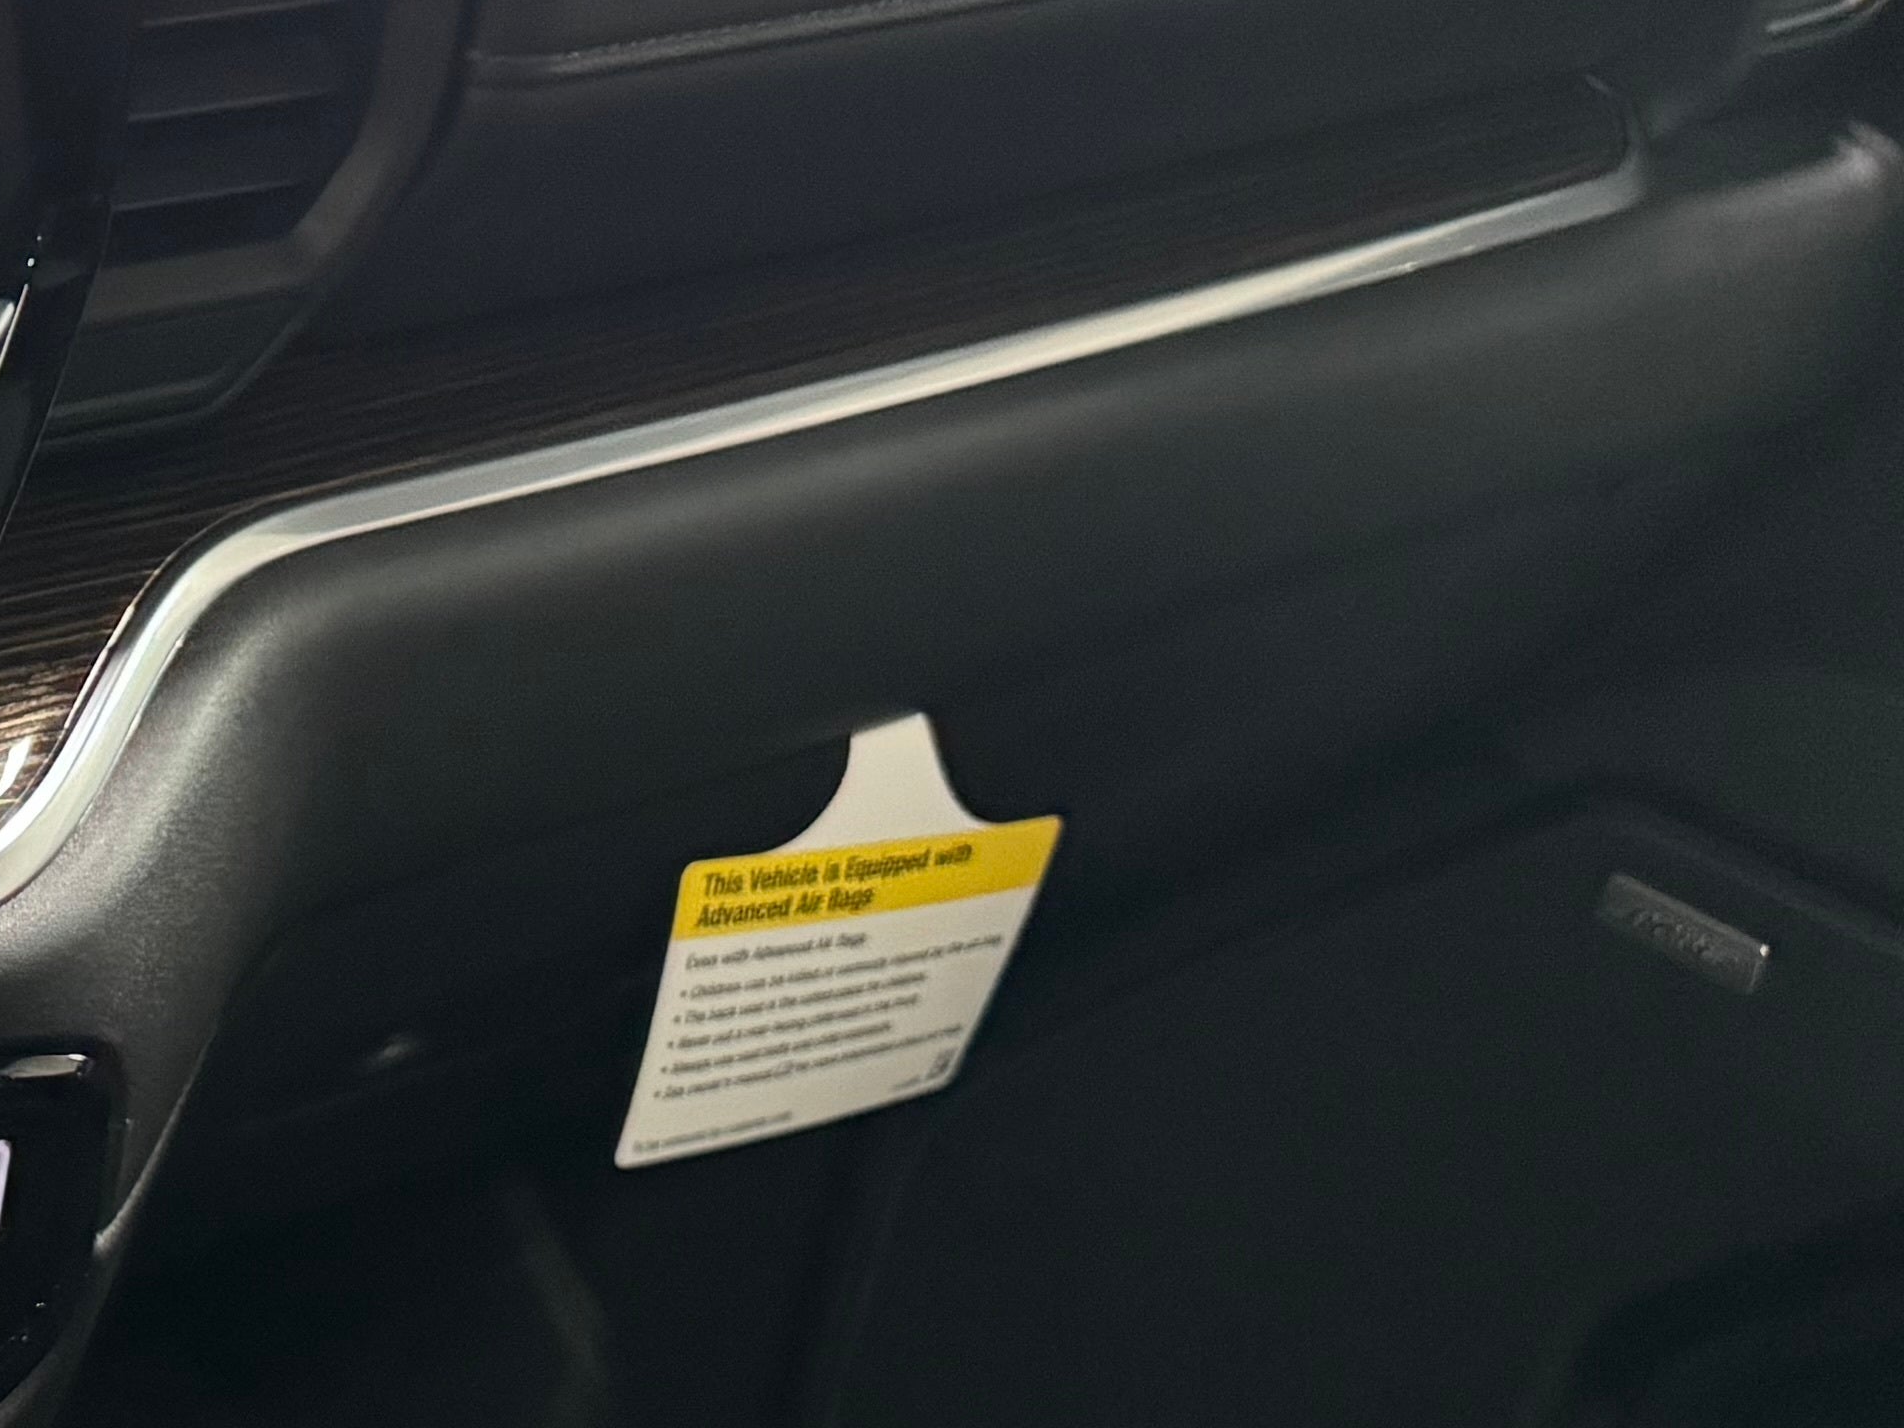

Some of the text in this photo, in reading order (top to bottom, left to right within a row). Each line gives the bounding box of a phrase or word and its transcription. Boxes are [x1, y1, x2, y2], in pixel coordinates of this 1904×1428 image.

[704, 872, 742, 897] This
[750, 862, 818, 892] Vehicle
[824, 859, 839, 882] is
[844, 849, 929, 883] Equipped
[695, 886, 874, 928] Advanced Air Bags
